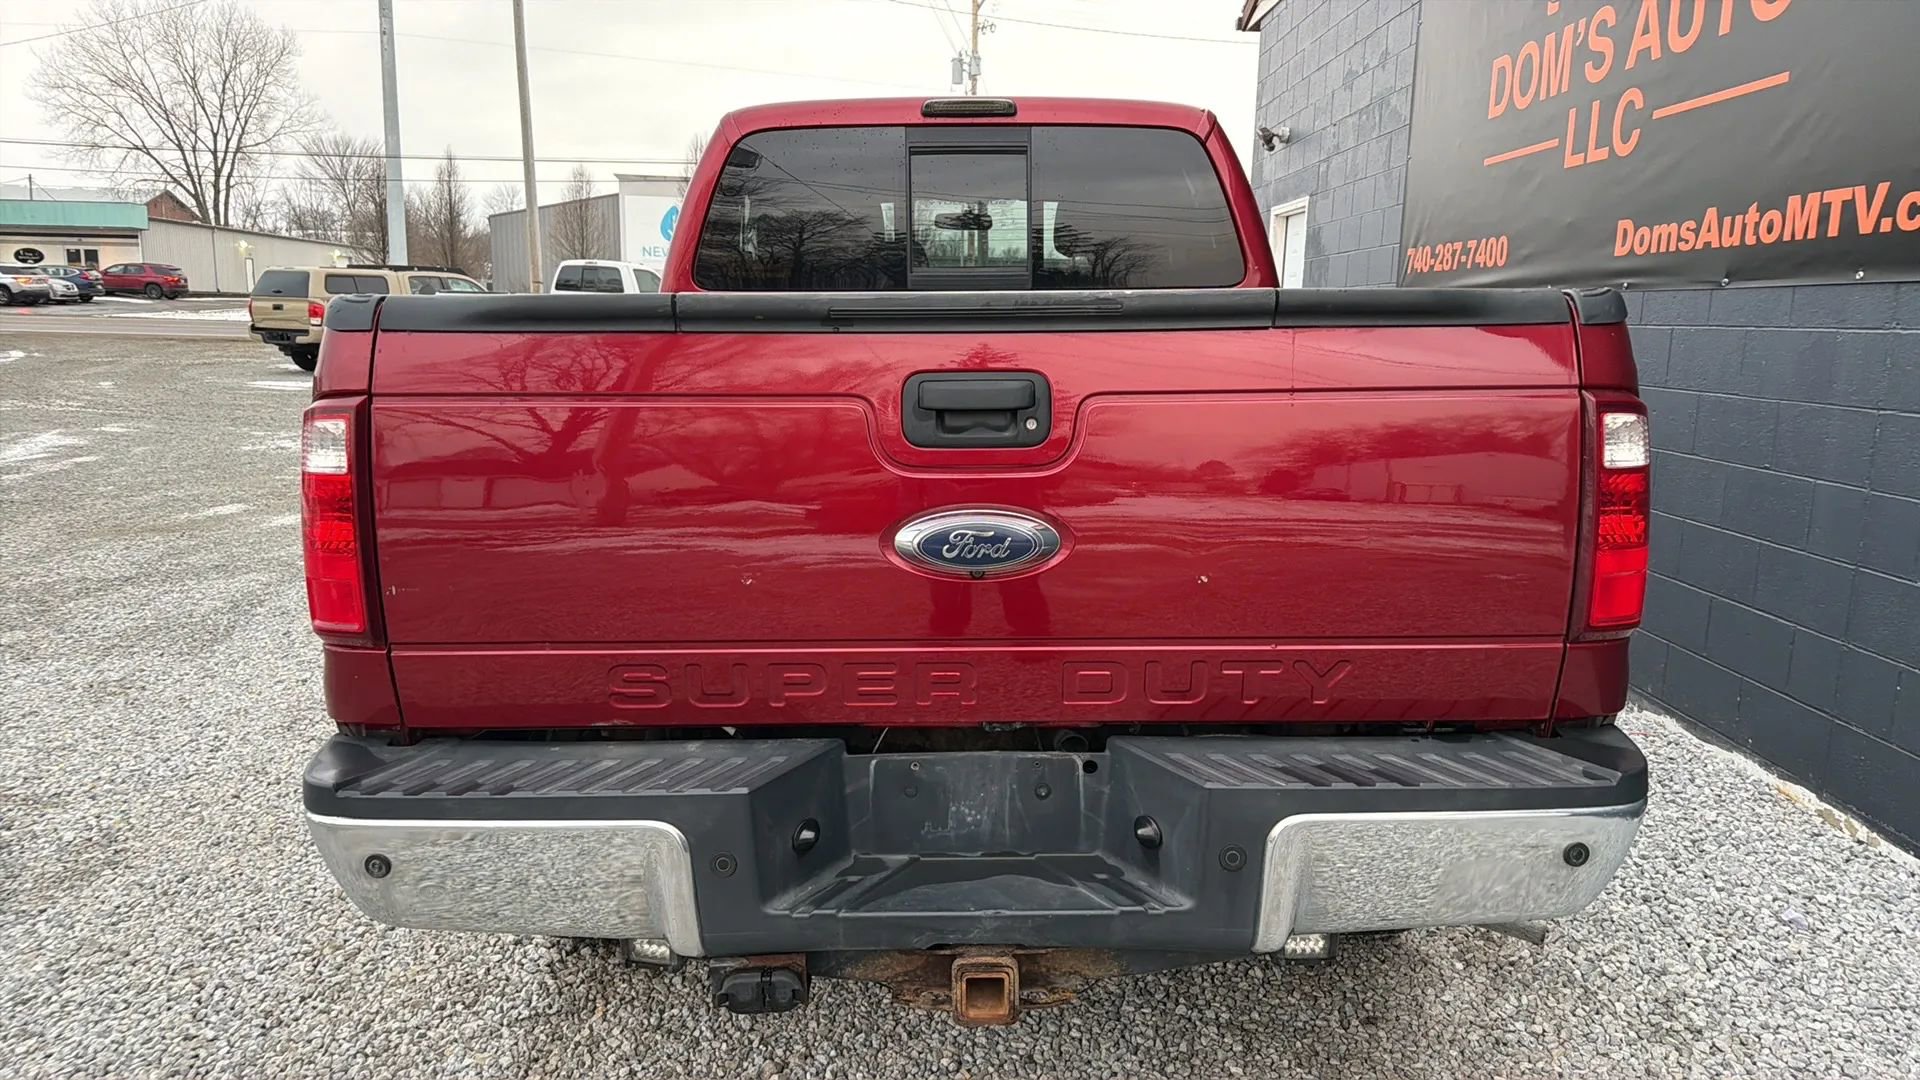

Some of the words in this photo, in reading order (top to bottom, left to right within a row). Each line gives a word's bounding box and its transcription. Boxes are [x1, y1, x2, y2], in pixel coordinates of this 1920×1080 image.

[1487, 5, 1616, 120] DOM'S
[1624, 0, 1792, 70] AU
[1563, 87, 1644, 168] LLC
[1406, 235, 1508, 274] 740-287-7400
[942, 530, 1012, 559] Ford
[607, 662, 977, 709] SUPER
[1062, 660, 1352, 705] DUTY
